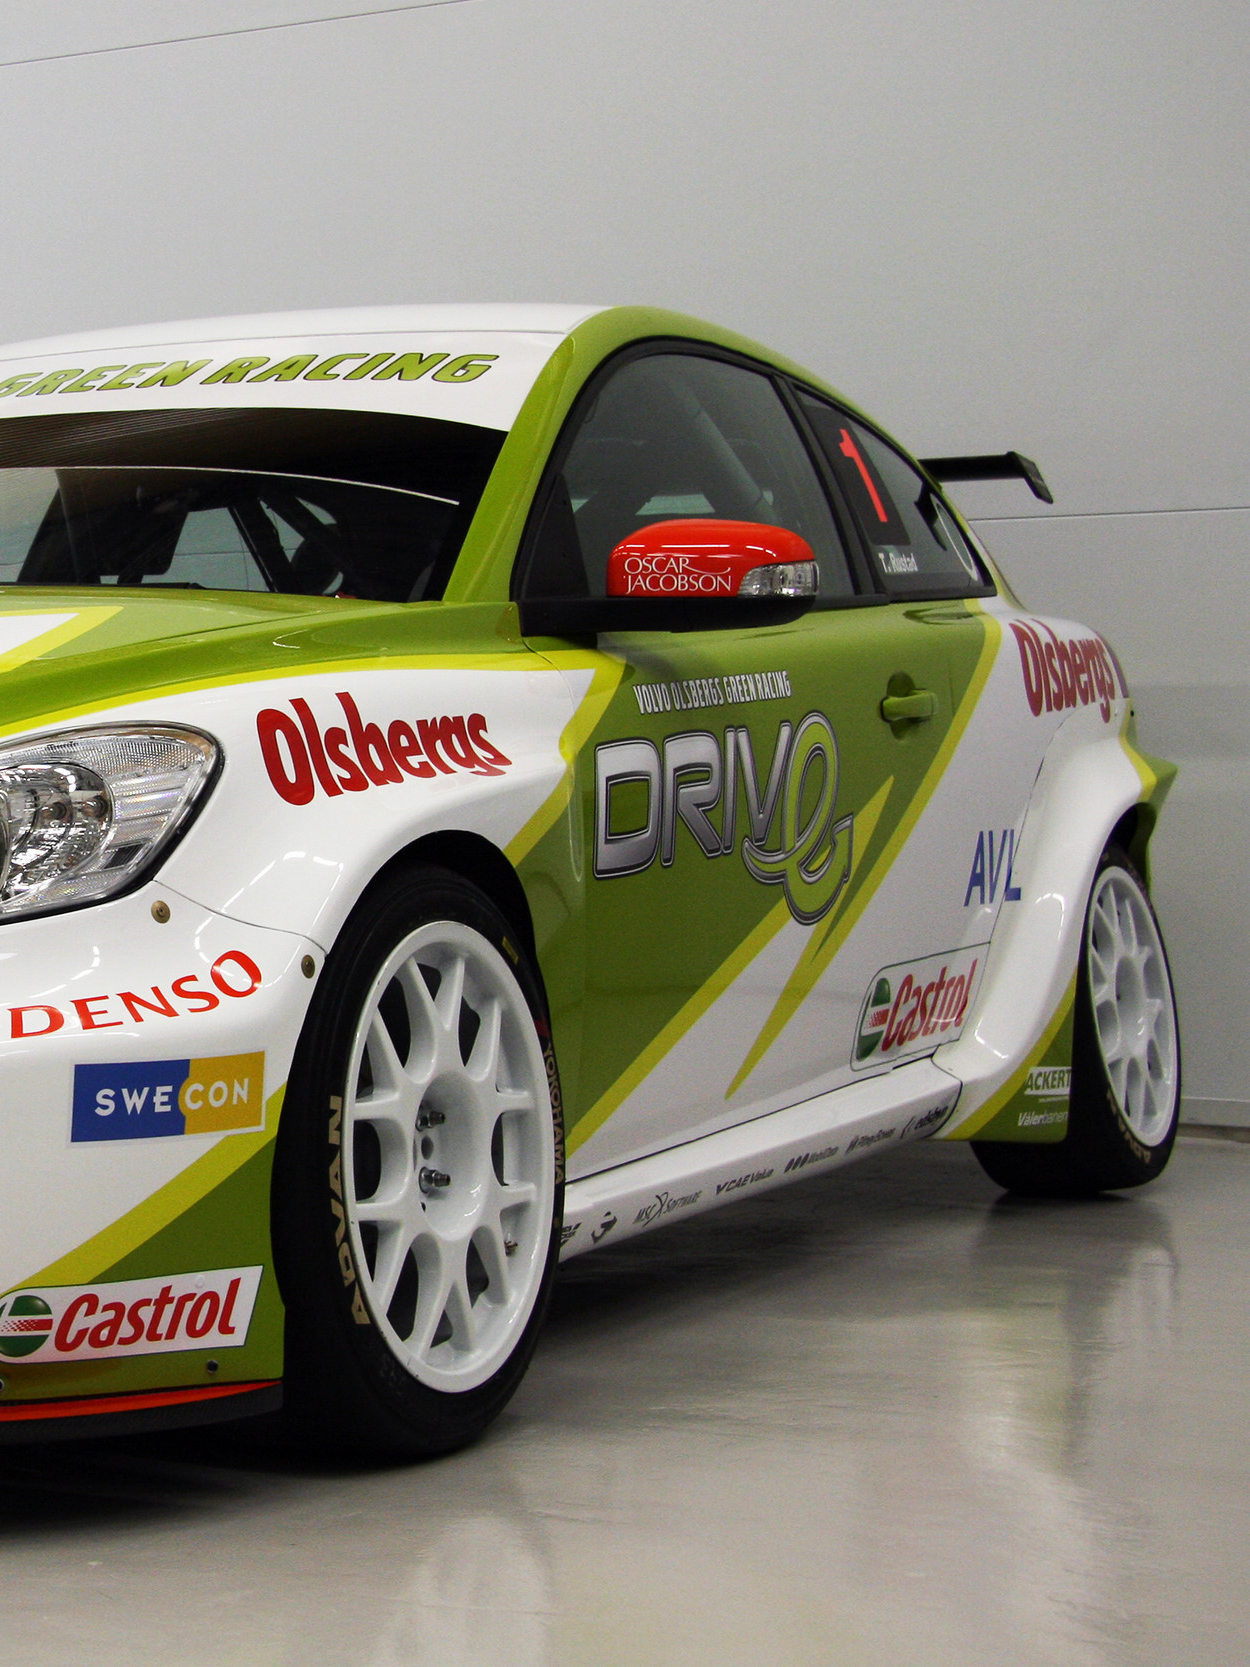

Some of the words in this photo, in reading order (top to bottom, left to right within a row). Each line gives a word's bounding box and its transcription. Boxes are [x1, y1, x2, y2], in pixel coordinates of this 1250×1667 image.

[200, 352, 499, 384] RACING
[839, 429, 888, 523] 1
[624, 556, 730, 576] OSCAR
[624, 574, 732, 593] JACOBSON
[632, 683, 671, 714] VOLVO
[670, 677, 724, 711] OLSBERGS
[722, 673, 756, 705] GREEN
[754, 670, 792, 700] RACING
[1009, 618, 1115, 724] Olsbergs
[256, 691, 513, 803] Olsbergs
[964, 829, 1022, 907] AVL
[9, 950, 262, 1038] DENSO
[882, 957, 979, 1052] Castrol
[543, 1042, 565, 1186] YOKOHAMA
[328, 1095, 371, 1325] ADVAN
[55, 1277, 241, 1352] Castrol
